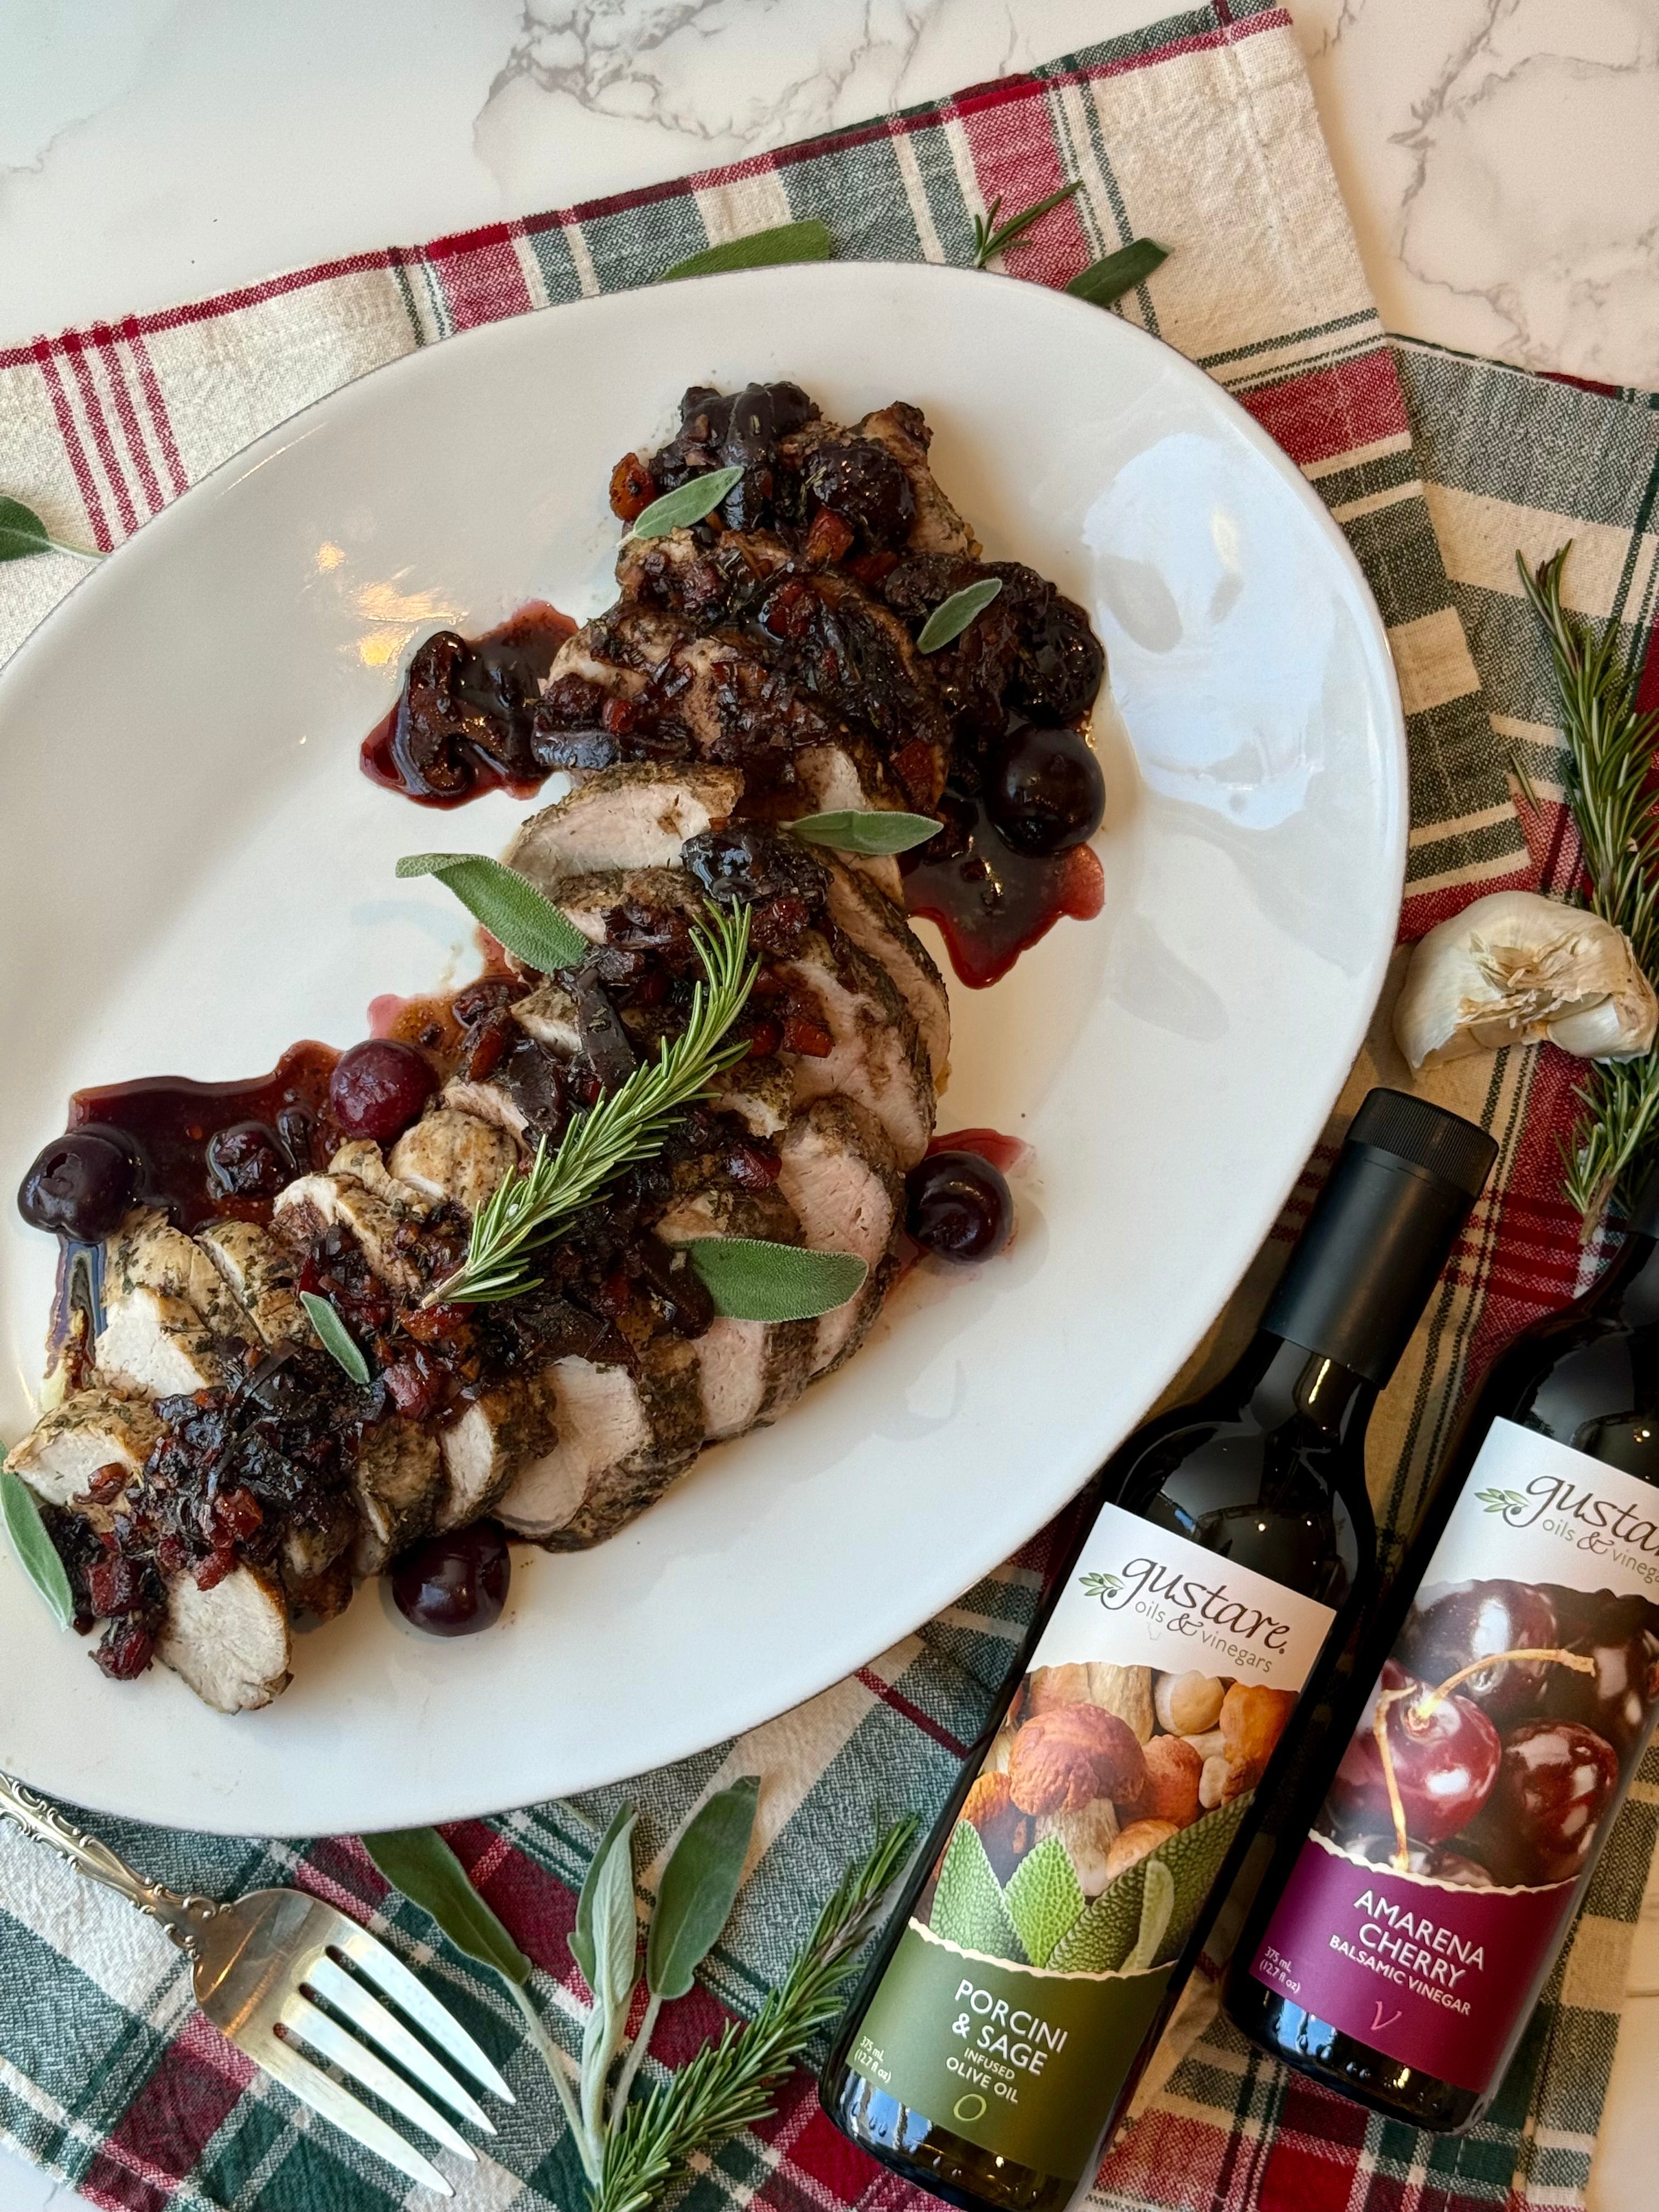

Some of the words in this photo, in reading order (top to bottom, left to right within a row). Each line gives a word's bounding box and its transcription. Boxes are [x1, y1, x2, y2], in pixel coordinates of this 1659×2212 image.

[1503, 1476, 1659, 1556] gusta
[1542, 1519, 1576, 1542] oils
[1576, 1531, 1615, 1555] &
[1135, 1601, 1165, 1623] oils
[1166, 1613, 1204, 1636] &
[1201, 1630, 1272, 1673] vinegars
[1353, 1890, 1483, 1971] AMARENA
[1265, 1946, 1280, 1962] 375
[1279, 1959, 1291, 1973] mL
[1329, 1935, 1407, 1985] BALSAMIC
[1408, 1975, 1471, 2016] VINEGAR
[1359, 1923, 1466, 1988] CHERRY
[1285, 1979, 1300, 1994] oz)
[955, 1979, 1068, 2053] PORCINI
[1370, 2001, 1402, 2030] V
[860, 2035, 874, 2052] 375
[872, 2048, 884, 2062] mL
[952, 2013, 970, 2039] &
[977, 2025, 1048, 2075] SAGE
[964, 2047, 1015, 2080] INFUSED
[877, 2069, 891, 2084] oz)
[946, 2057, 992, 2089] OLIVE
[994, 2082, 1018, 2103] OIL
